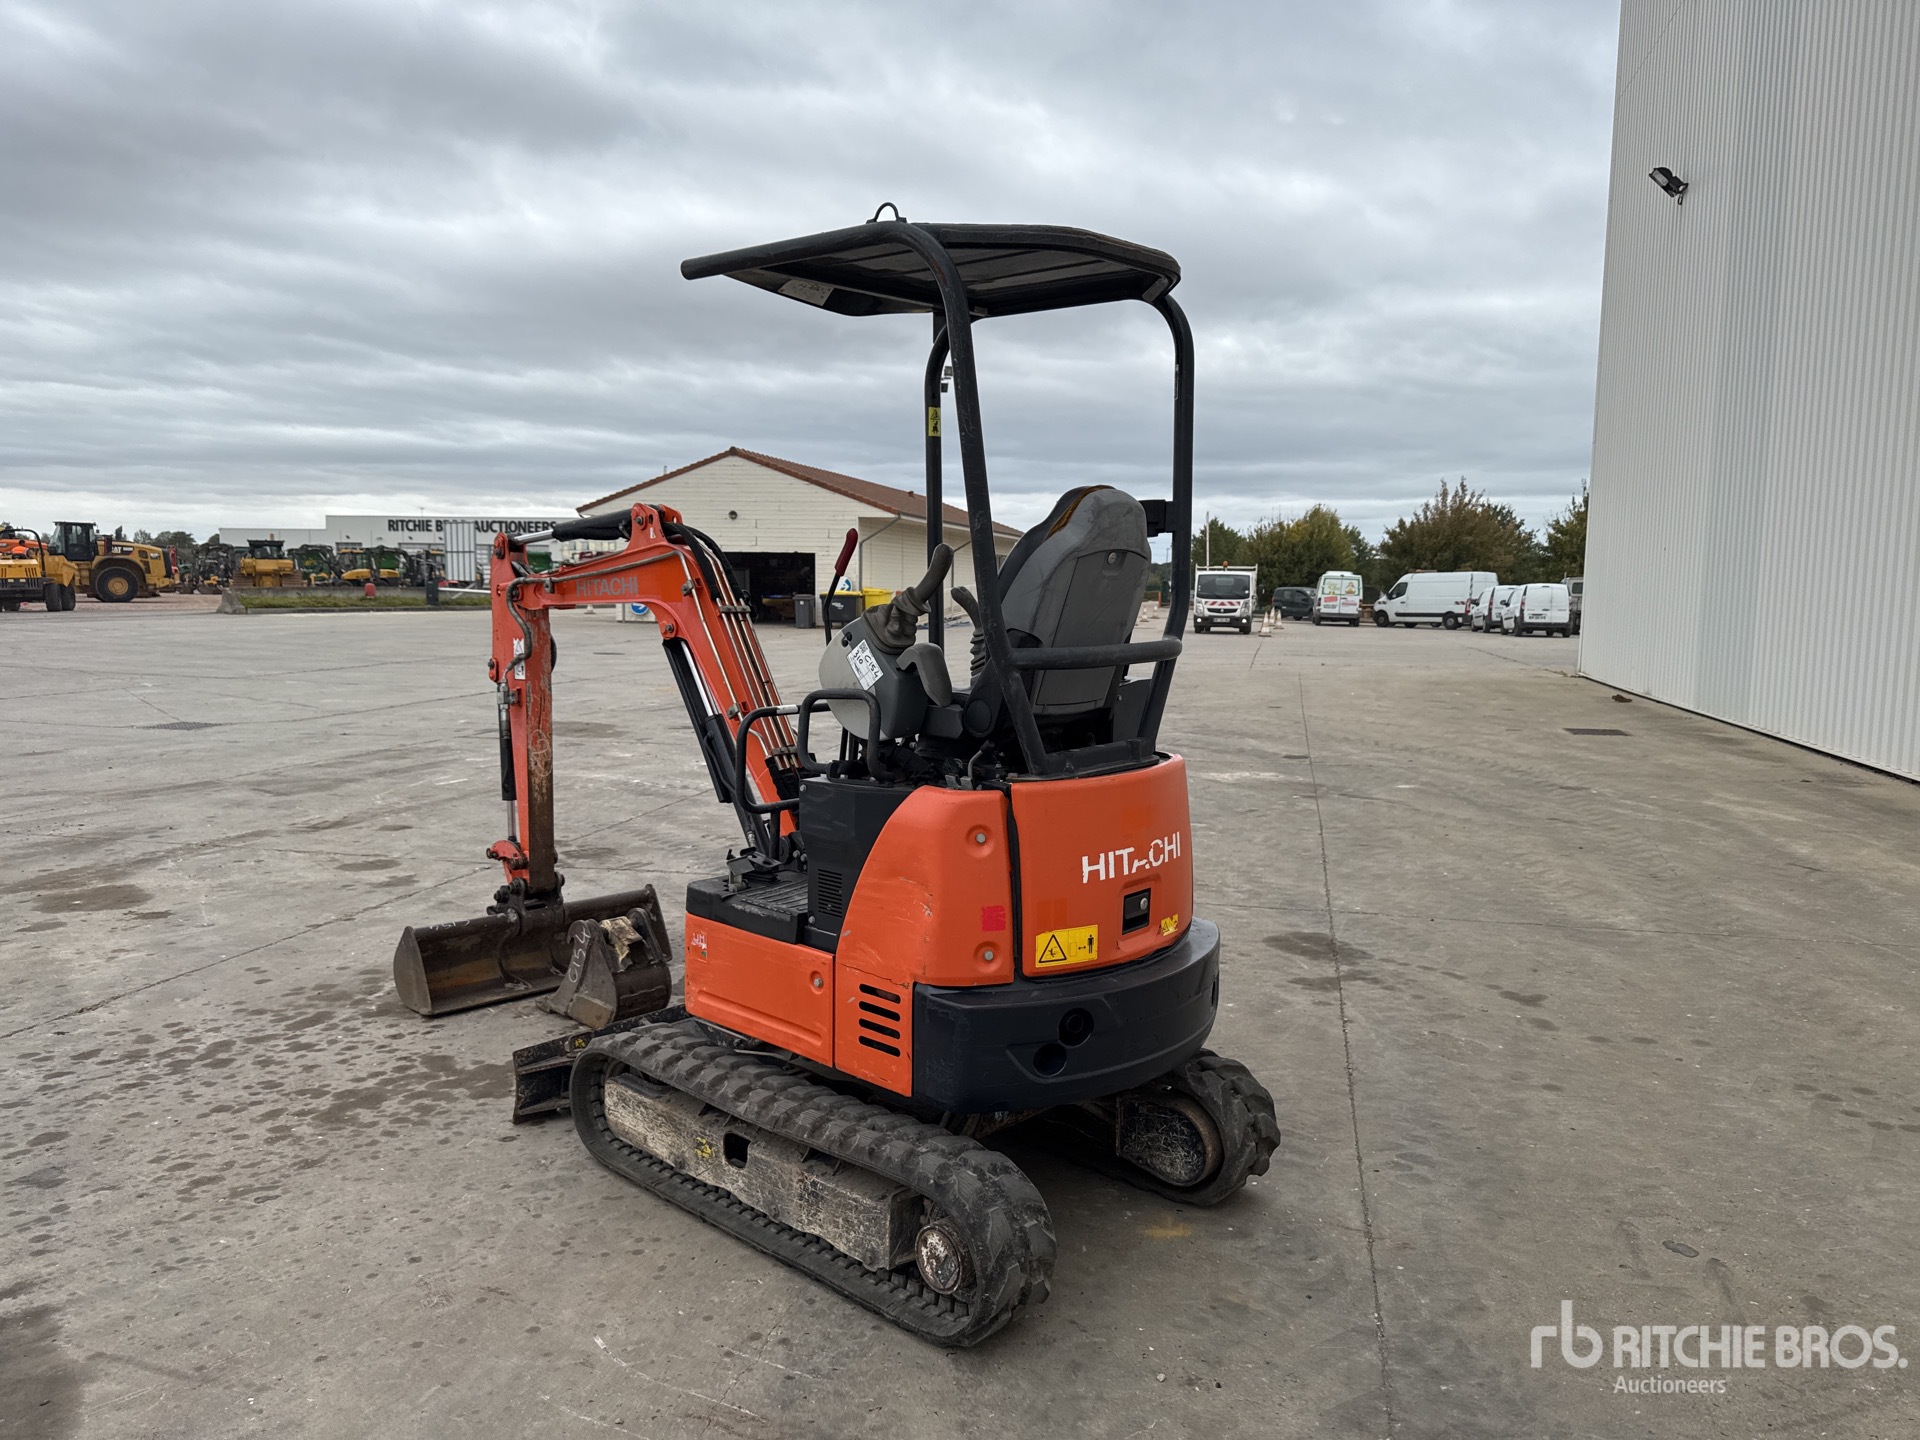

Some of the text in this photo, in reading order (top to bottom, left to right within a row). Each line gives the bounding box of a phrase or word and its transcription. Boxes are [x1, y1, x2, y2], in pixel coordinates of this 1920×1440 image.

[388, 519, 432, 532] RITCHIE
[576, 576, 639, 597] HITACHI
[853, 649, 864, 665] 310
